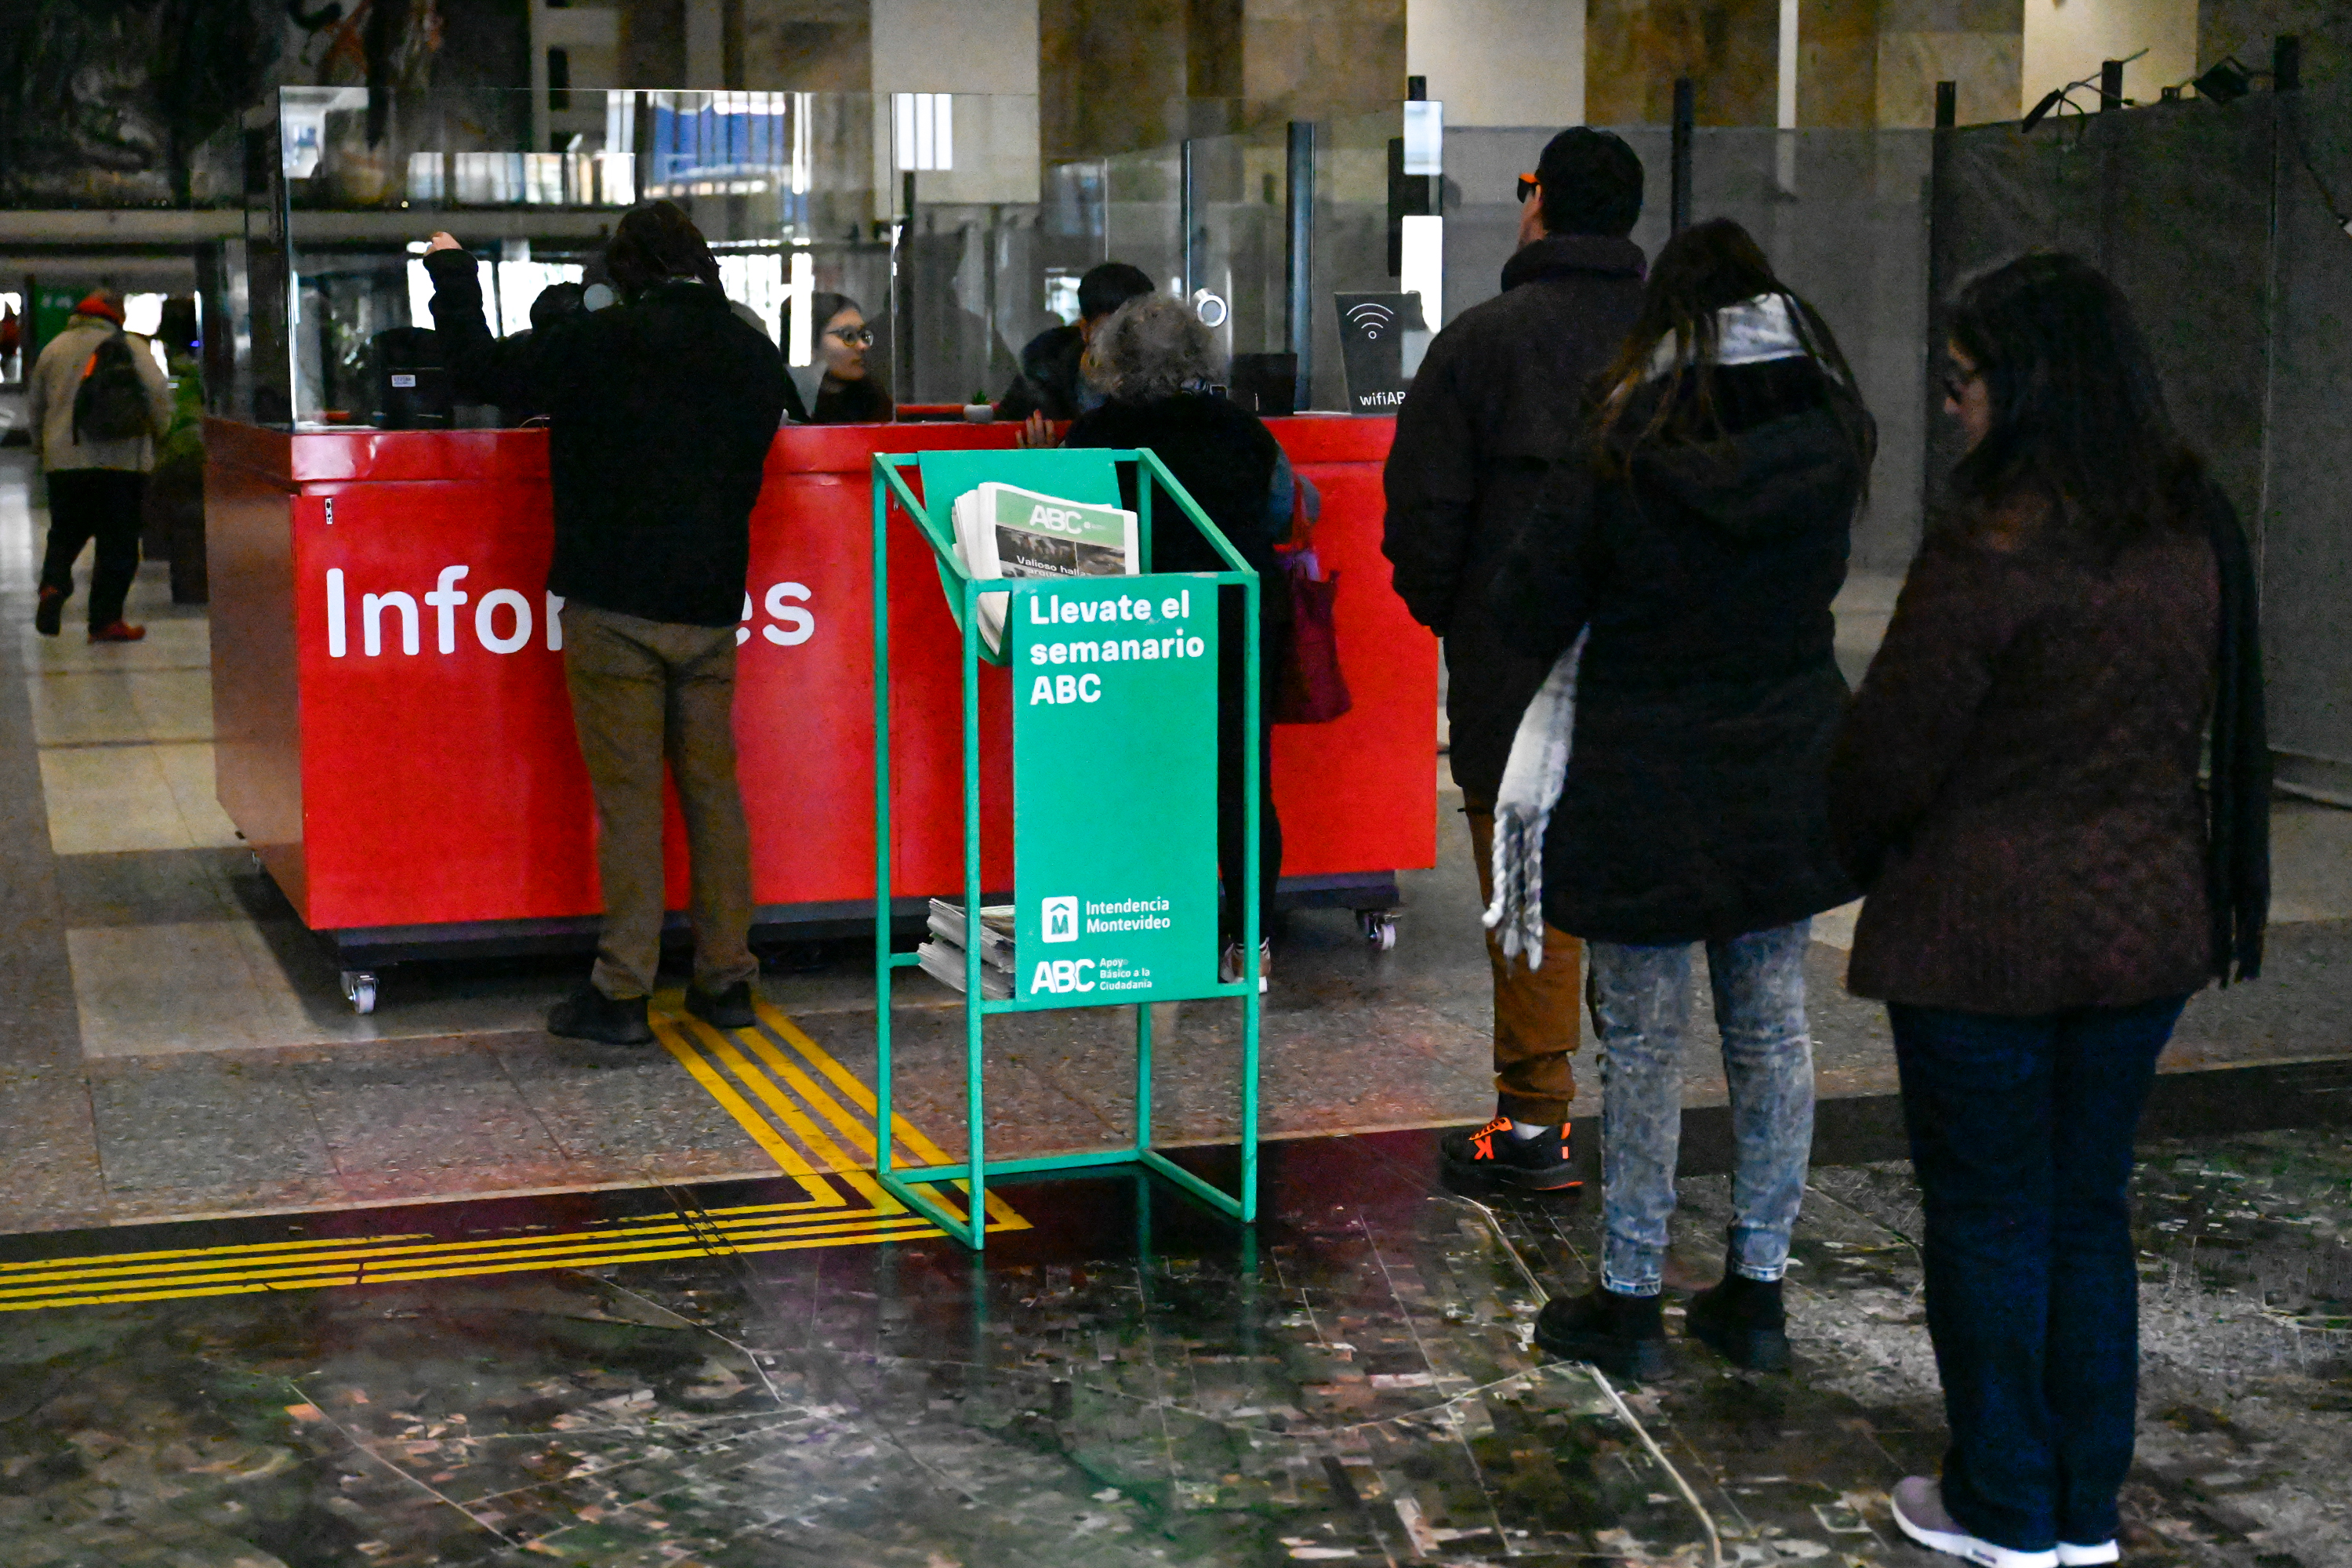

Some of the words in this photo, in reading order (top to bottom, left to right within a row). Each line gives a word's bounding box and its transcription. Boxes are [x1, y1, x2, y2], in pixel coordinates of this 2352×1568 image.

[1029, 504, 1083, 535] ABC
[1016, 554, 1058, 572] Valioso
[325, 564, 815, 658] Infors
[1029, 593, 1152, 625] Llevate
[1160, 589, 1190, 619] el
[1029, 627, 1205, 666] semanario
[1029, 673, 1102, 706] ABC
[1086, 895, 1170, 916] Intendencia
[1086, 914, 1171, 933] Montevideo
[1029, 958, 1096, 995] ABC
[1099, 968, 1131, 979] Básico
[1133, 969, 1139, 978] a
[1142, 967, 1151, 977] la
